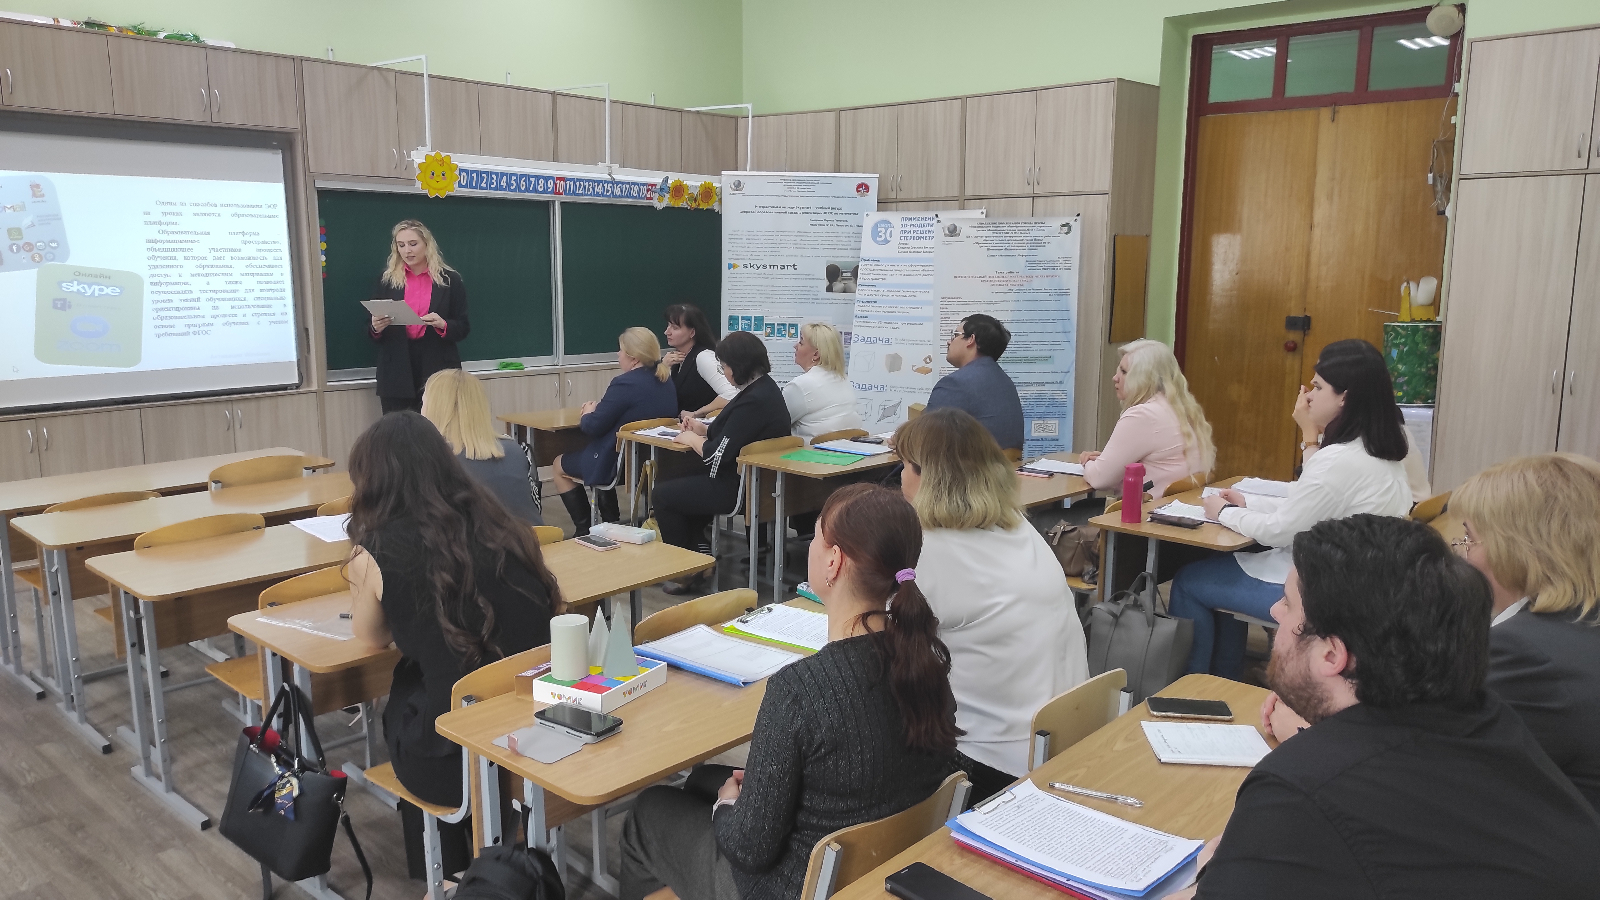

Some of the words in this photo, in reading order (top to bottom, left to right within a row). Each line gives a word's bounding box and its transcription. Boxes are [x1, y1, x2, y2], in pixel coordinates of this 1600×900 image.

[461, 172, 466, 185] 0
[472, 174, 477, 186] 1
[481, 174, 487, 187] 2
[491, 175, 496, 187] 3
[500, 176, 506, 188] 4
[510, 176, 516, 189] 5
[520, 177, 526, 190] 6
[530, 178, 535, 190] 7
[538, 178, 544, 191] 8
[548, 180, 553, 192] 9
[556, 180, 564, 192] 10
[566, 180, 573, 193] 11
[576, 182, 583, 194] 12
[585, 182, 592, 195] 13
[594, 183, 602, 195] 14
[604, 183, 612, 196] 15
[614, 184, 621, 196] 16
[622, 185, 630, 196] 17
[631, 185, 638, 197] 18
[640, 186, 646, 197] 19
[742, 263, 798, 271] skysmart
[74, 271, 111, 280] Онлайн
[62, 280, 120, 296] skype
[853, 334, 892, 344] Задача:
